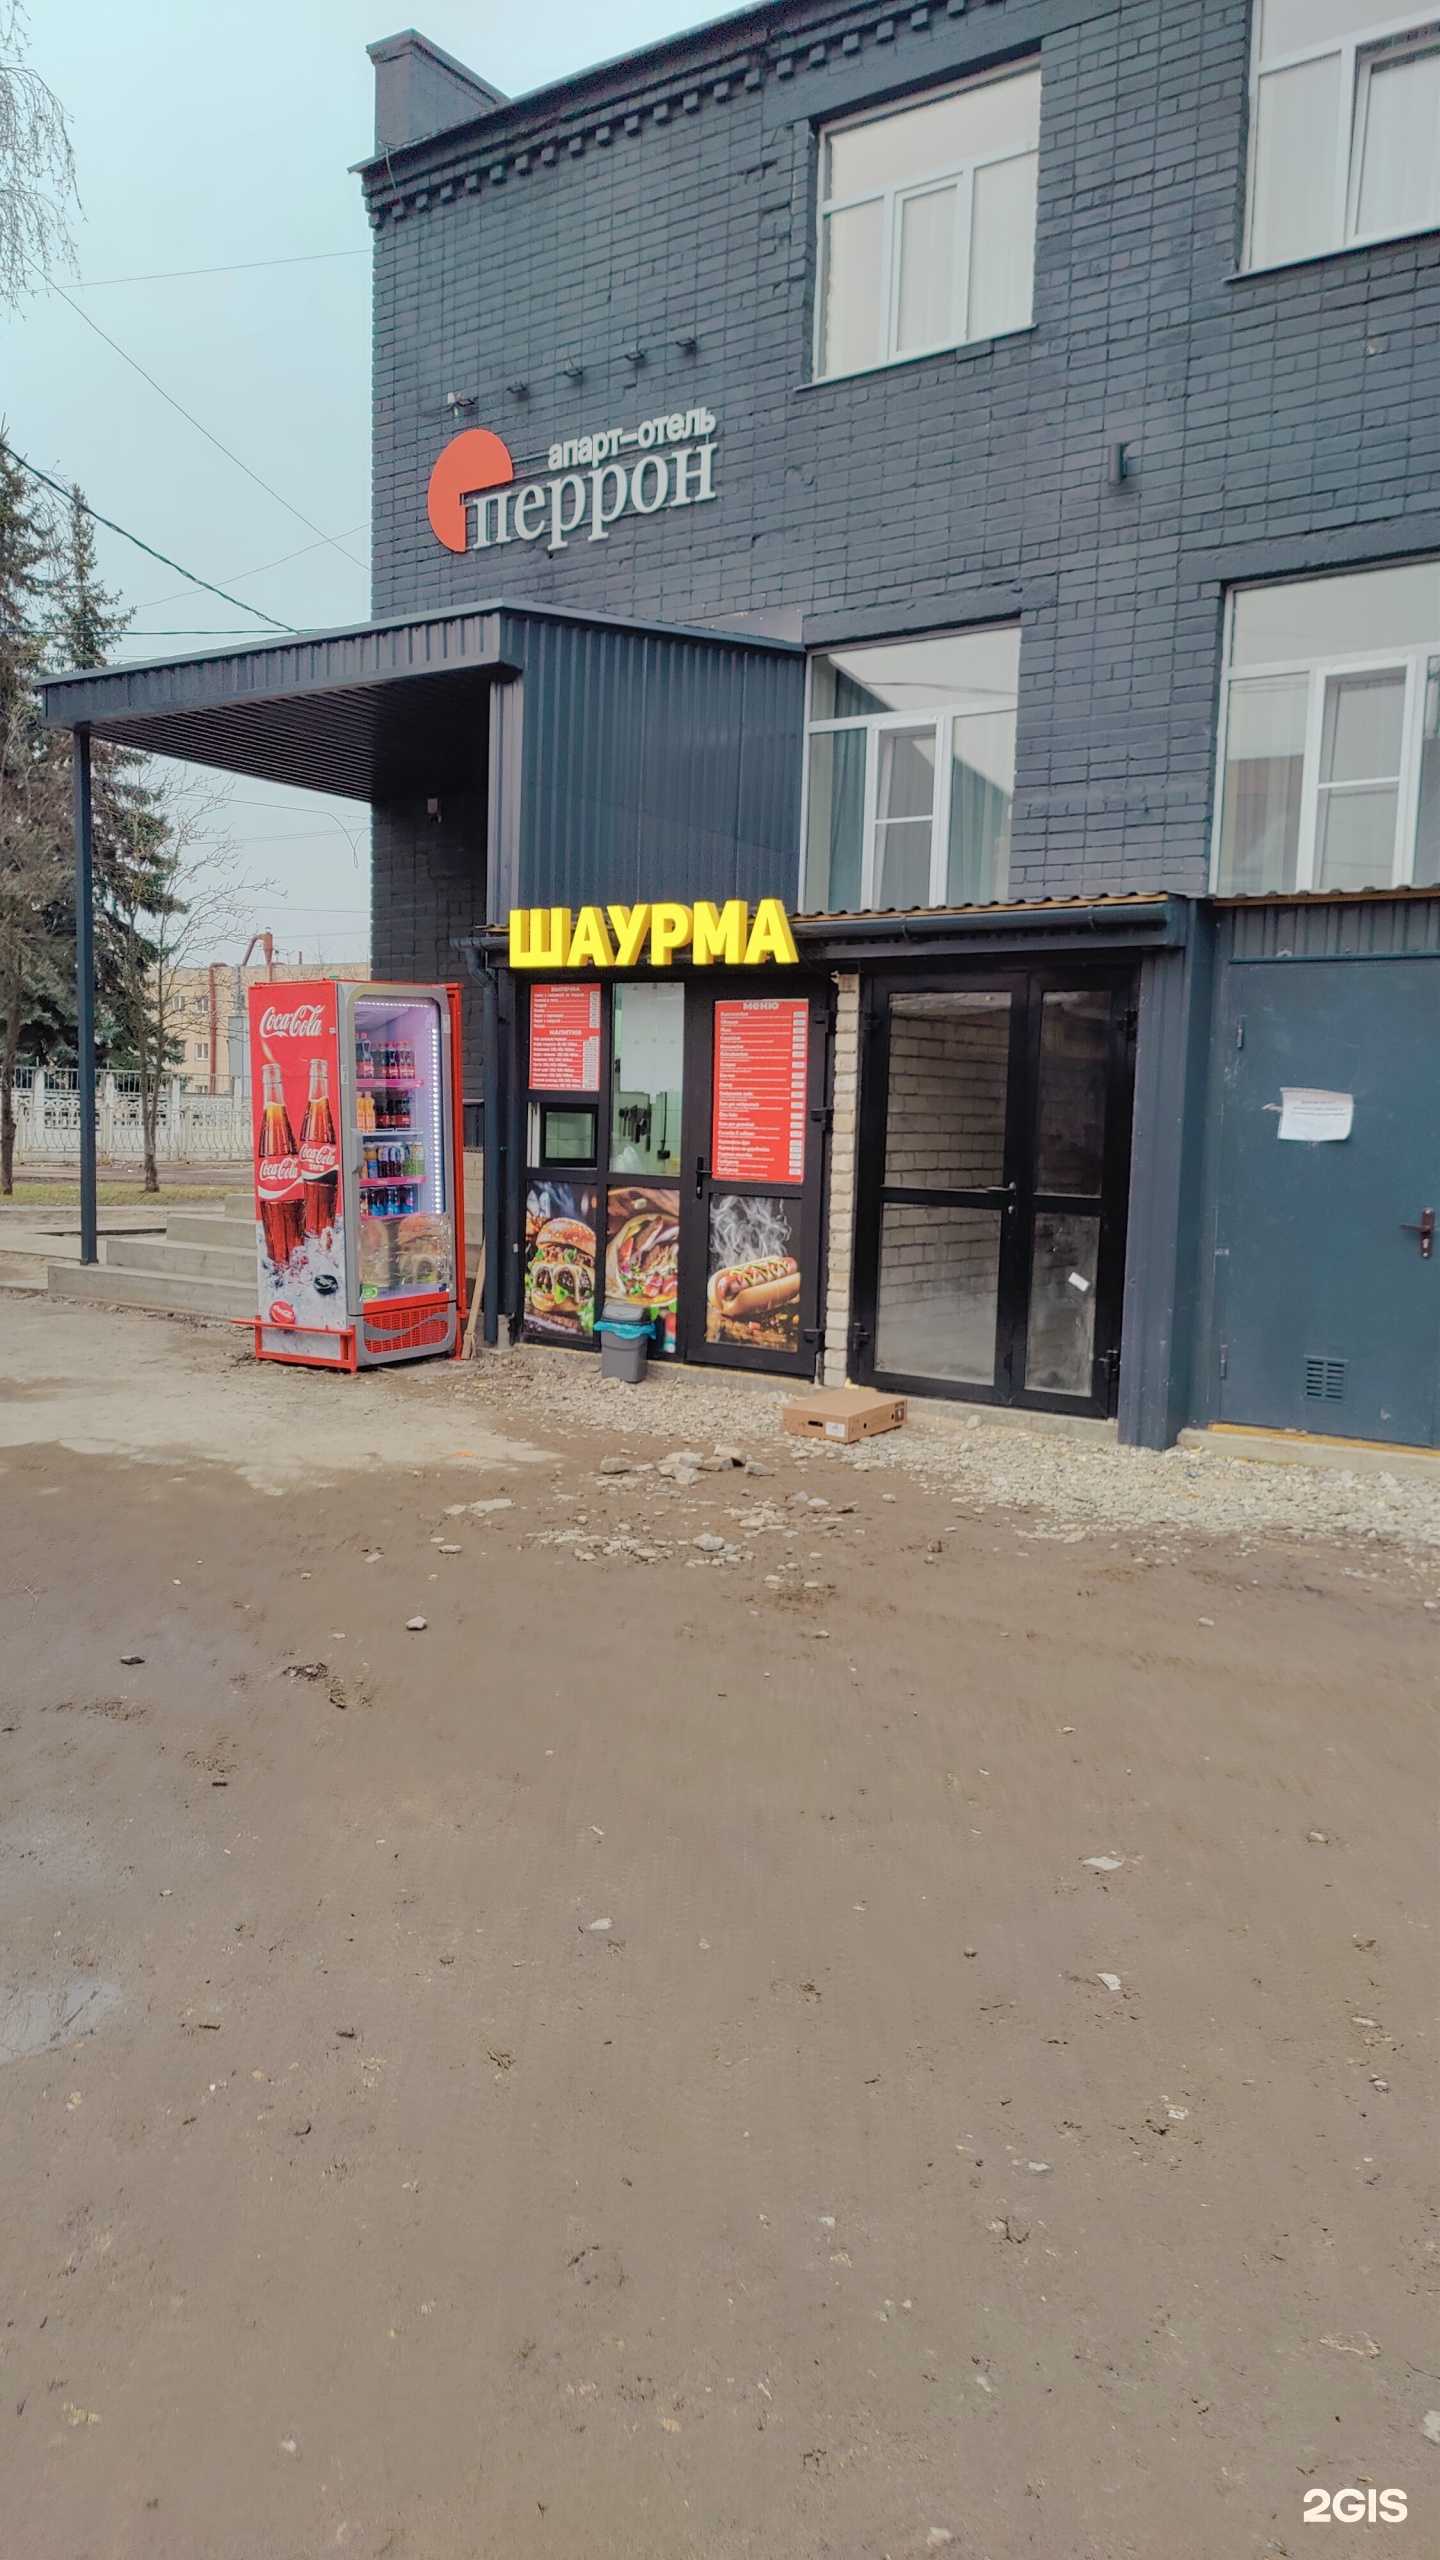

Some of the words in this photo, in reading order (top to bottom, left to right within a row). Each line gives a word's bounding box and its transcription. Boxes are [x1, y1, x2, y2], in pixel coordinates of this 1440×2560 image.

[547, 406, 718, 470] апарт-отель
[464, 442, 719, 551] перрон
[509, 898, 799, 969] ШАУРМА
[259, 1004, 326, 1039] Coca-Cola
